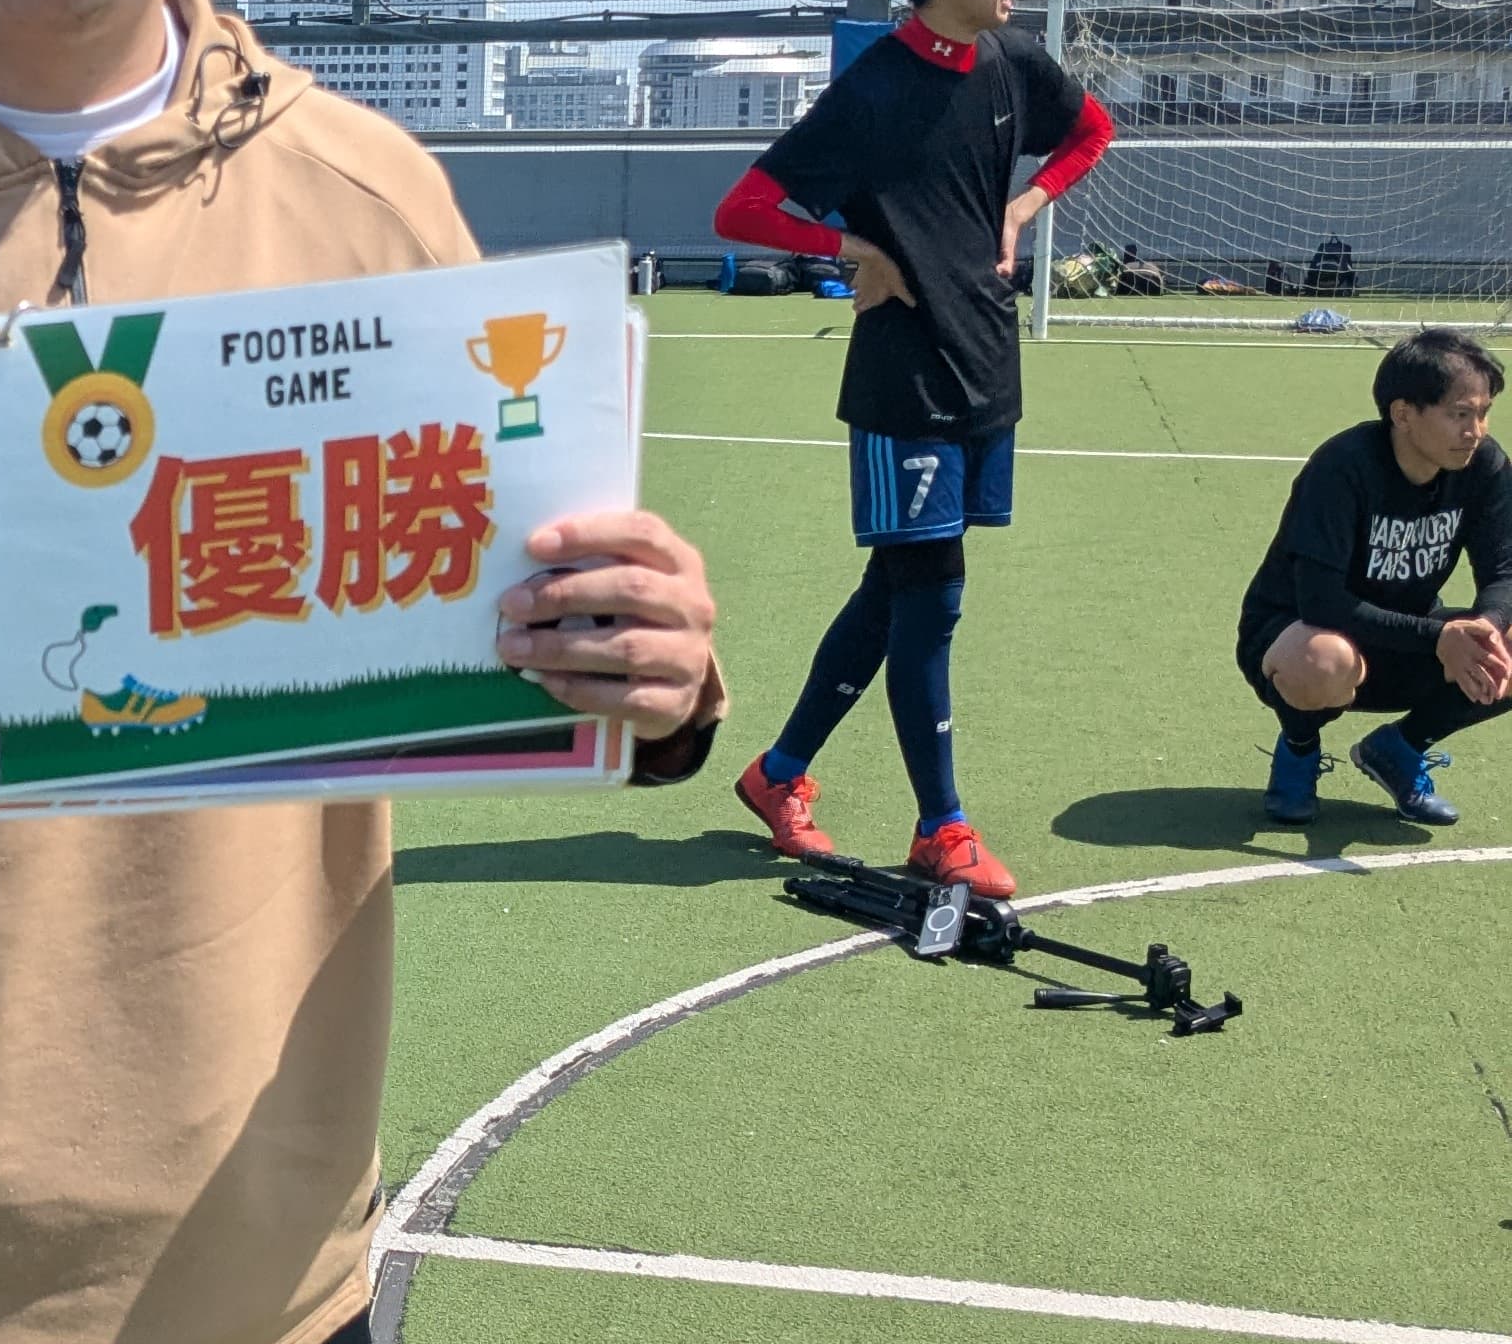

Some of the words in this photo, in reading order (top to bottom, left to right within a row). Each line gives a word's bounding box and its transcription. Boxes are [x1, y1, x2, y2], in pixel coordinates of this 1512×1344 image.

[221, 316, 393, 367] FOOTBALL
[265, 367, 352, 408] GAME
[902, 456, 939, 519] 7
[129, 422, 495, 639] 優勝
[1414, 542, 1451, 578] OFF
